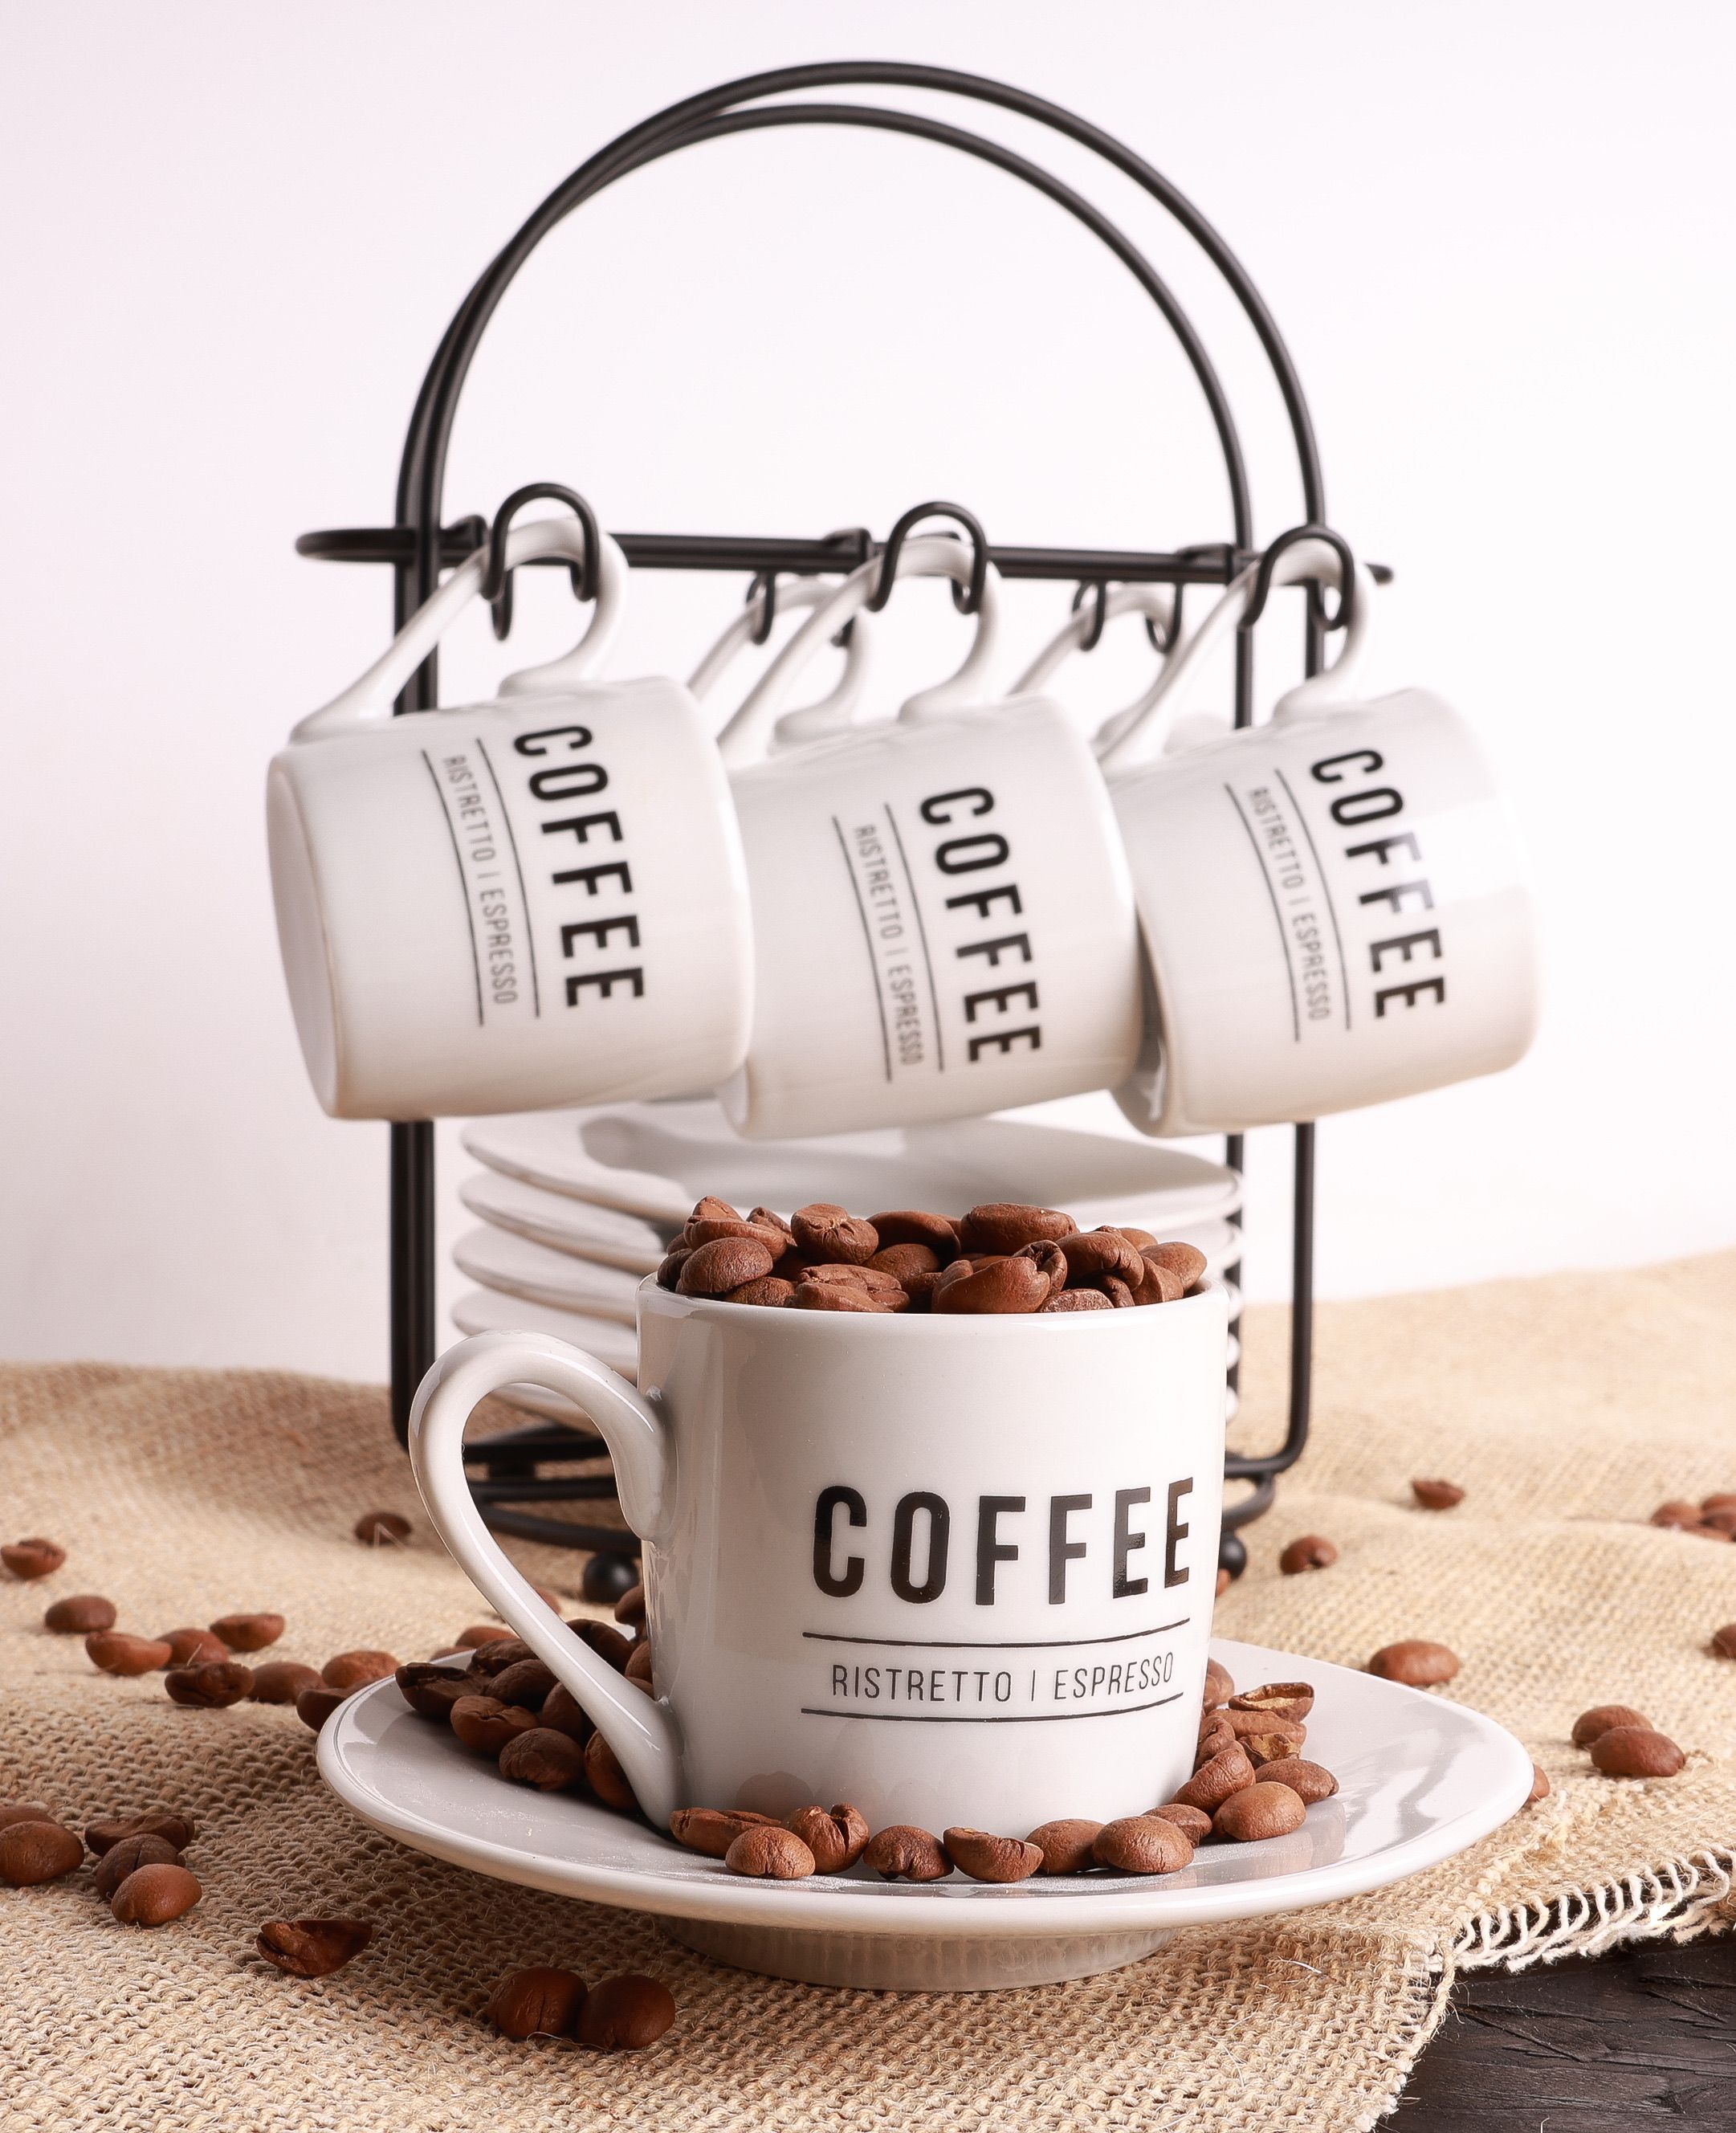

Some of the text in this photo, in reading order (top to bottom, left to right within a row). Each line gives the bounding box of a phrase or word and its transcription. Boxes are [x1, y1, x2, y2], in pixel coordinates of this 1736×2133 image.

[442, 755, 496, 863] RISTRETTO
[479, 888, 518, 1005] ESPRESSO
[513, 725, 645, 1008] COFFEE
[853, 824, 903, 941] RISTRETTO
[887, 964, 924, 1066] ESPRESSO
[919, 787, 1042, 1064] COFFEE
[1251, 788, 1305, 891] RISTRETTO
[1292, 912, 1331, 1022] ESPRESSO
[1310, 749, 1446, 1019] COFFEE
[812, 1477, 1193, 1606] COFFEE
[831, 1663, 1013, 1703] RISTRETTO
[1054, 1651, 1174, 1701] ESPRESSO
